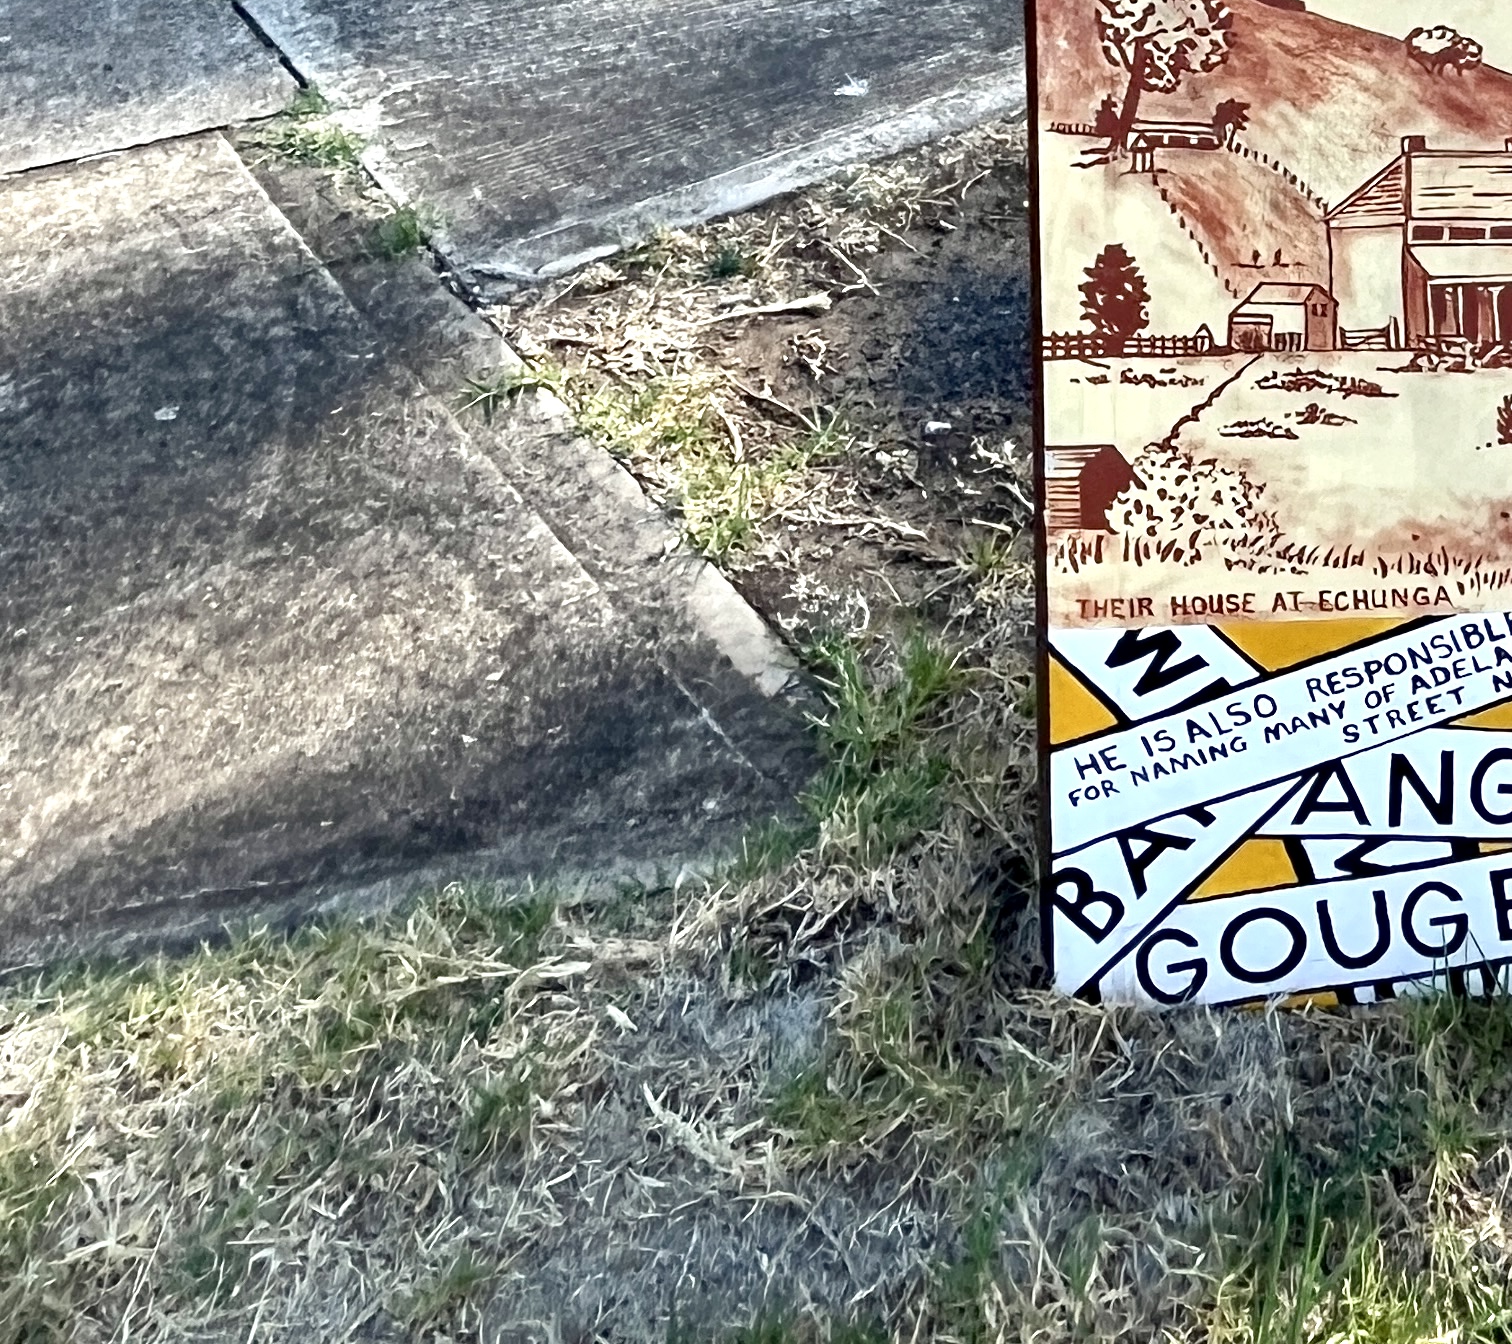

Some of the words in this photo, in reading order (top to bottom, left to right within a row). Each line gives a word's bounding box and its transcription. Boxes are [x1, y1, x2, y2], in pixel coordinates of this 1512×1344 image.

[1074, 594, 1155, 621] THEIR
[1169, 591, 1257, 619] HOUSE
[1317, 584, 1455, 614] ECHUNGA
[1067, 778, 1121, 808] FOR
[1129, 735, 1248, 788] NAMING
[1263, 699, 1347, 745] MANY
[1363, 681, 1396, 710] OF
[1073, 743, 1127, 781] HE
[1139, 728, 1177, 758] IS
[1185, 692, 1279, 745] ALSO
[1341, 684, 1466, 745] STREET
